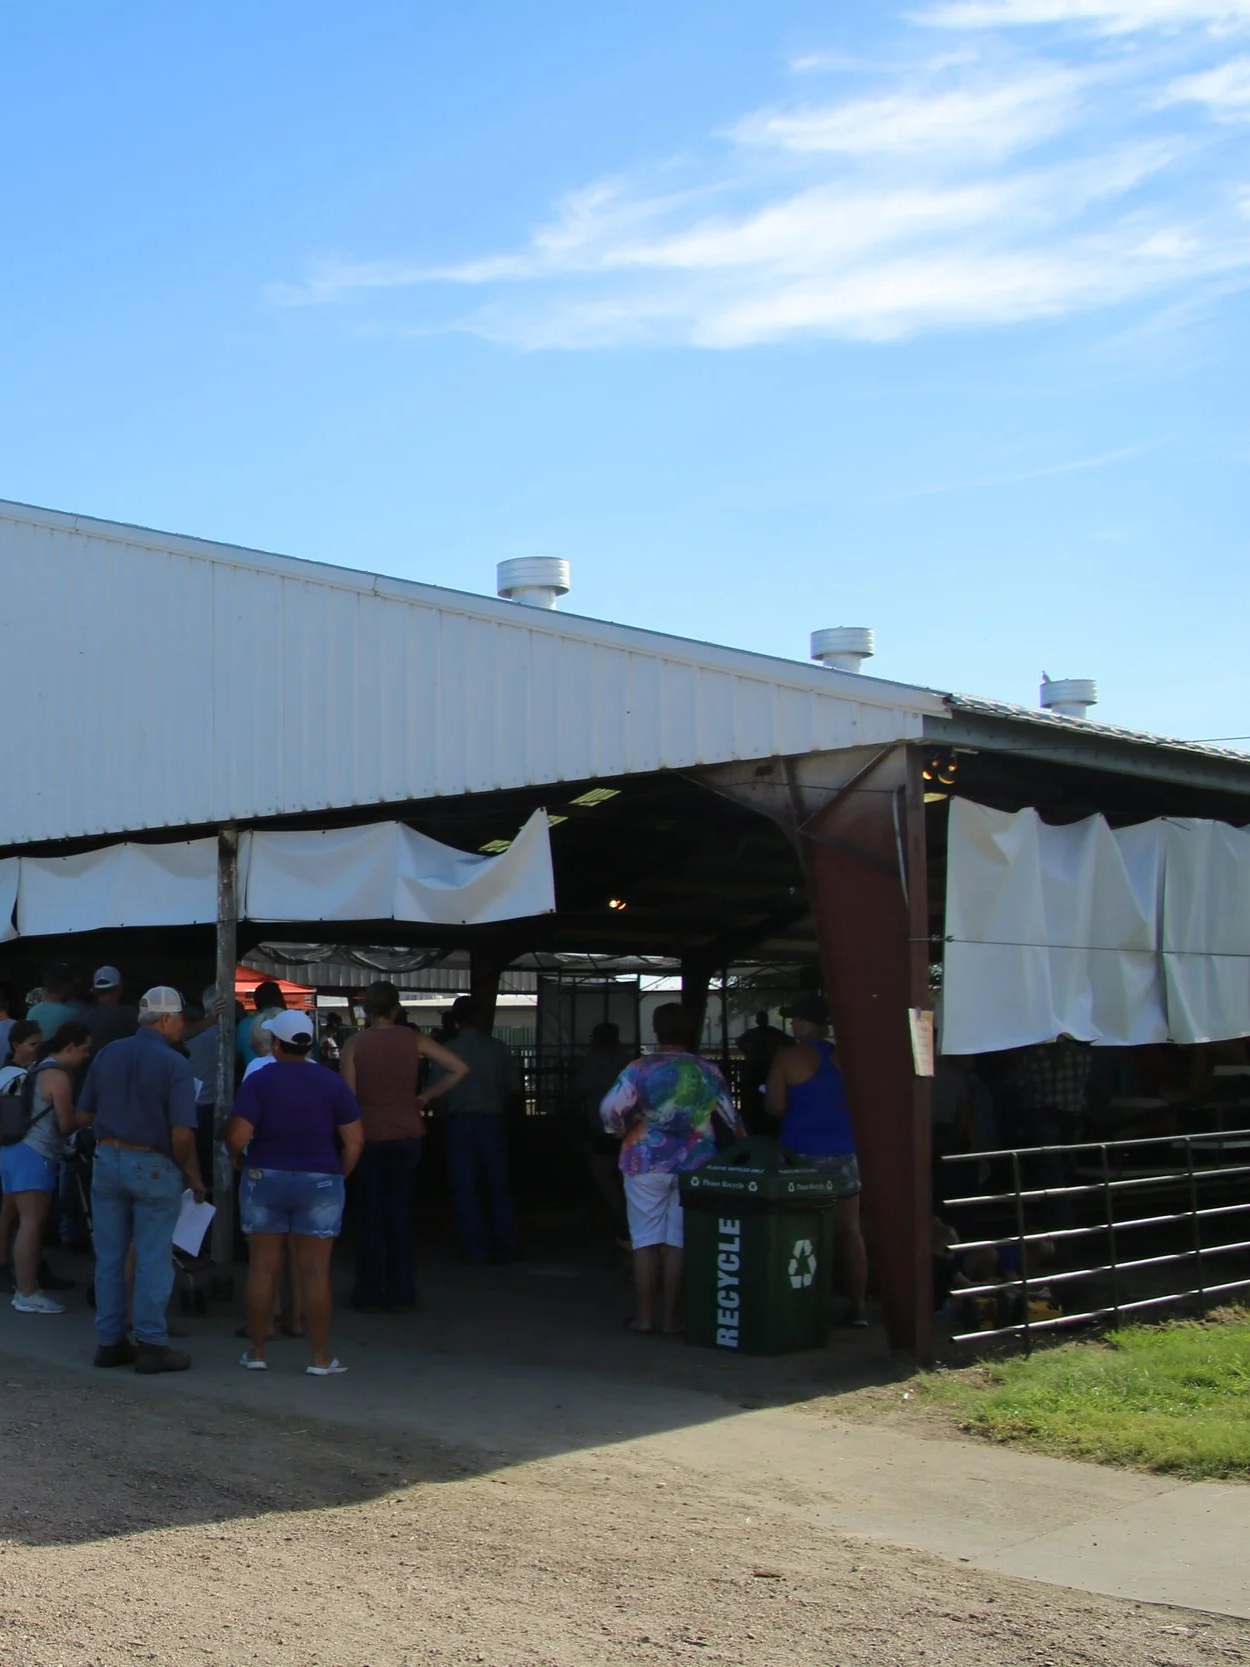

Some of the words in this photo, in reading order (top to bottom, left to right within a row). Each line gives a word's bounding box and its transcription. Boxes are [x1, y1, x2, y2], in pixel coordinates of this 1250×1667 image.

[702, 1178, 721, 1187] Please
[722, 1180, 744, 1189] Recycle
[716, 1218, 741, 1348] RECYCLE
